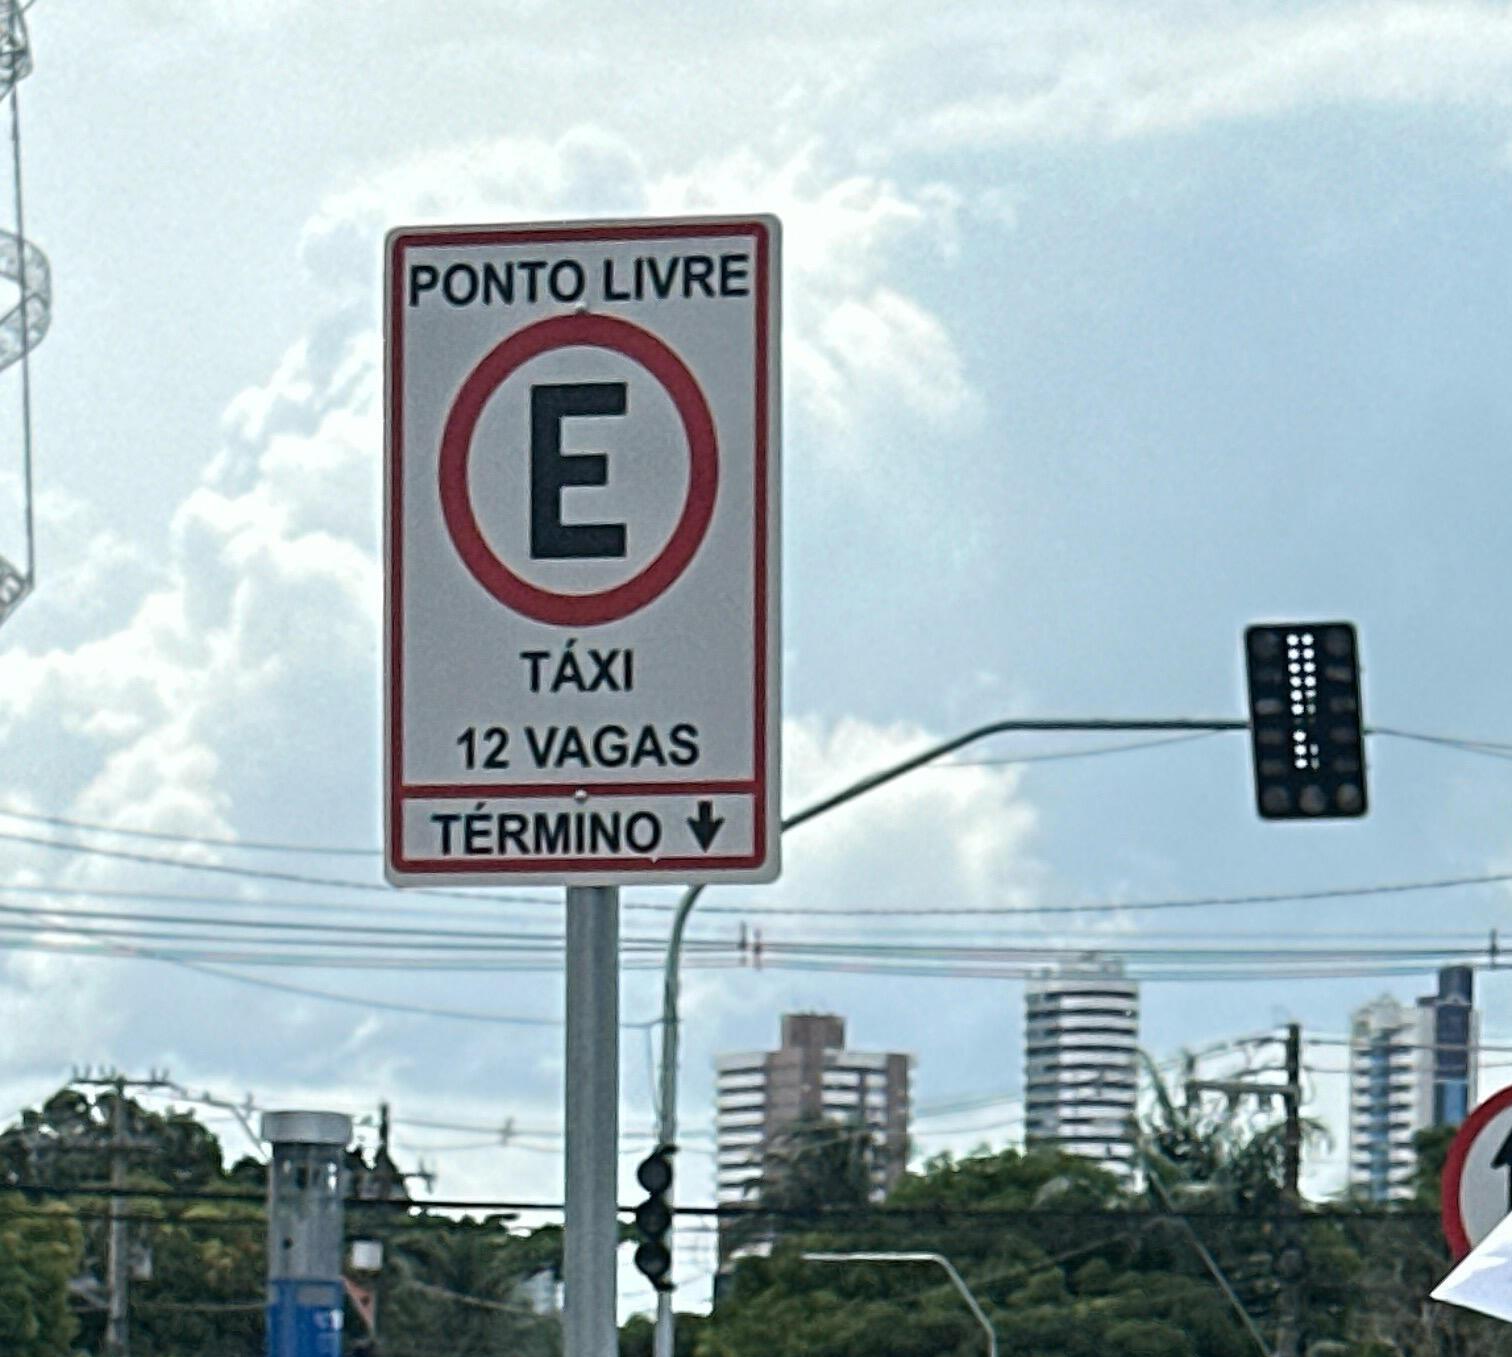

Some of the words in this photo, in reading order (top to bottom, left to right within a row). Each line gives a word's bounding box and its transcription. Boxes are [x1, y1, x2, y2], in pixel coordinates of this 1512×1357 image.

[409, 258, 585, 306] PONTO
[604, 253, 749, 301] LIVRE
[530, 382, 628, 560] E
[520, 638, 634, 693] TÁXI
[457, 727, 510, 770] 12
[525, 723, 700, 769] VAGAS
[431, 802, 662, 856] TÉRMINO
